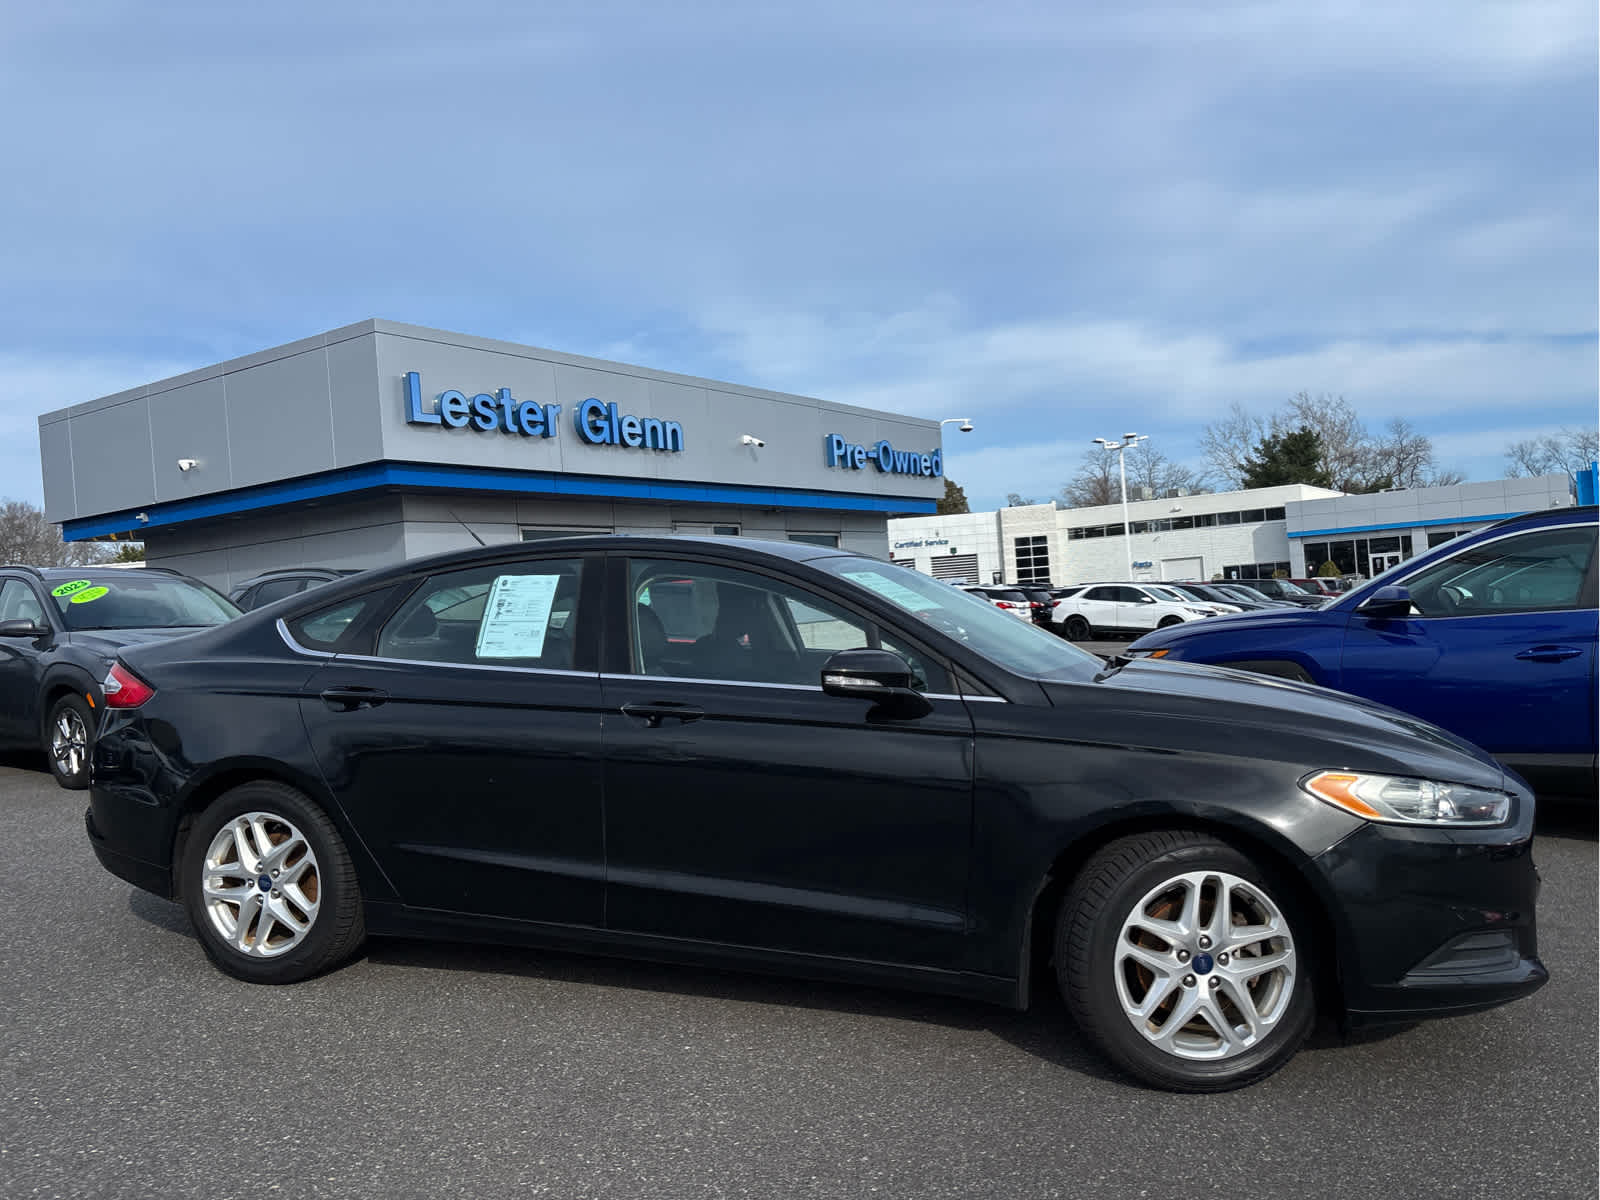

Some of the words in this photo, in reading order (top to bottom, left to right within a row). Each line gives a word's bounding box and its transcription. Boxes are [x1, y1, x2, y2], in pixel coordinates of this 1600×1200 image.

[402, 371, 561, 438] Lester
[573, 398, 684, 453] Glenn
[824, 432, 943, 478] Pre-Owned
[895, 541, 922, 549] Certified
[924, 539, 949, 547] Service
[56, 581, 88, 595] 2023
